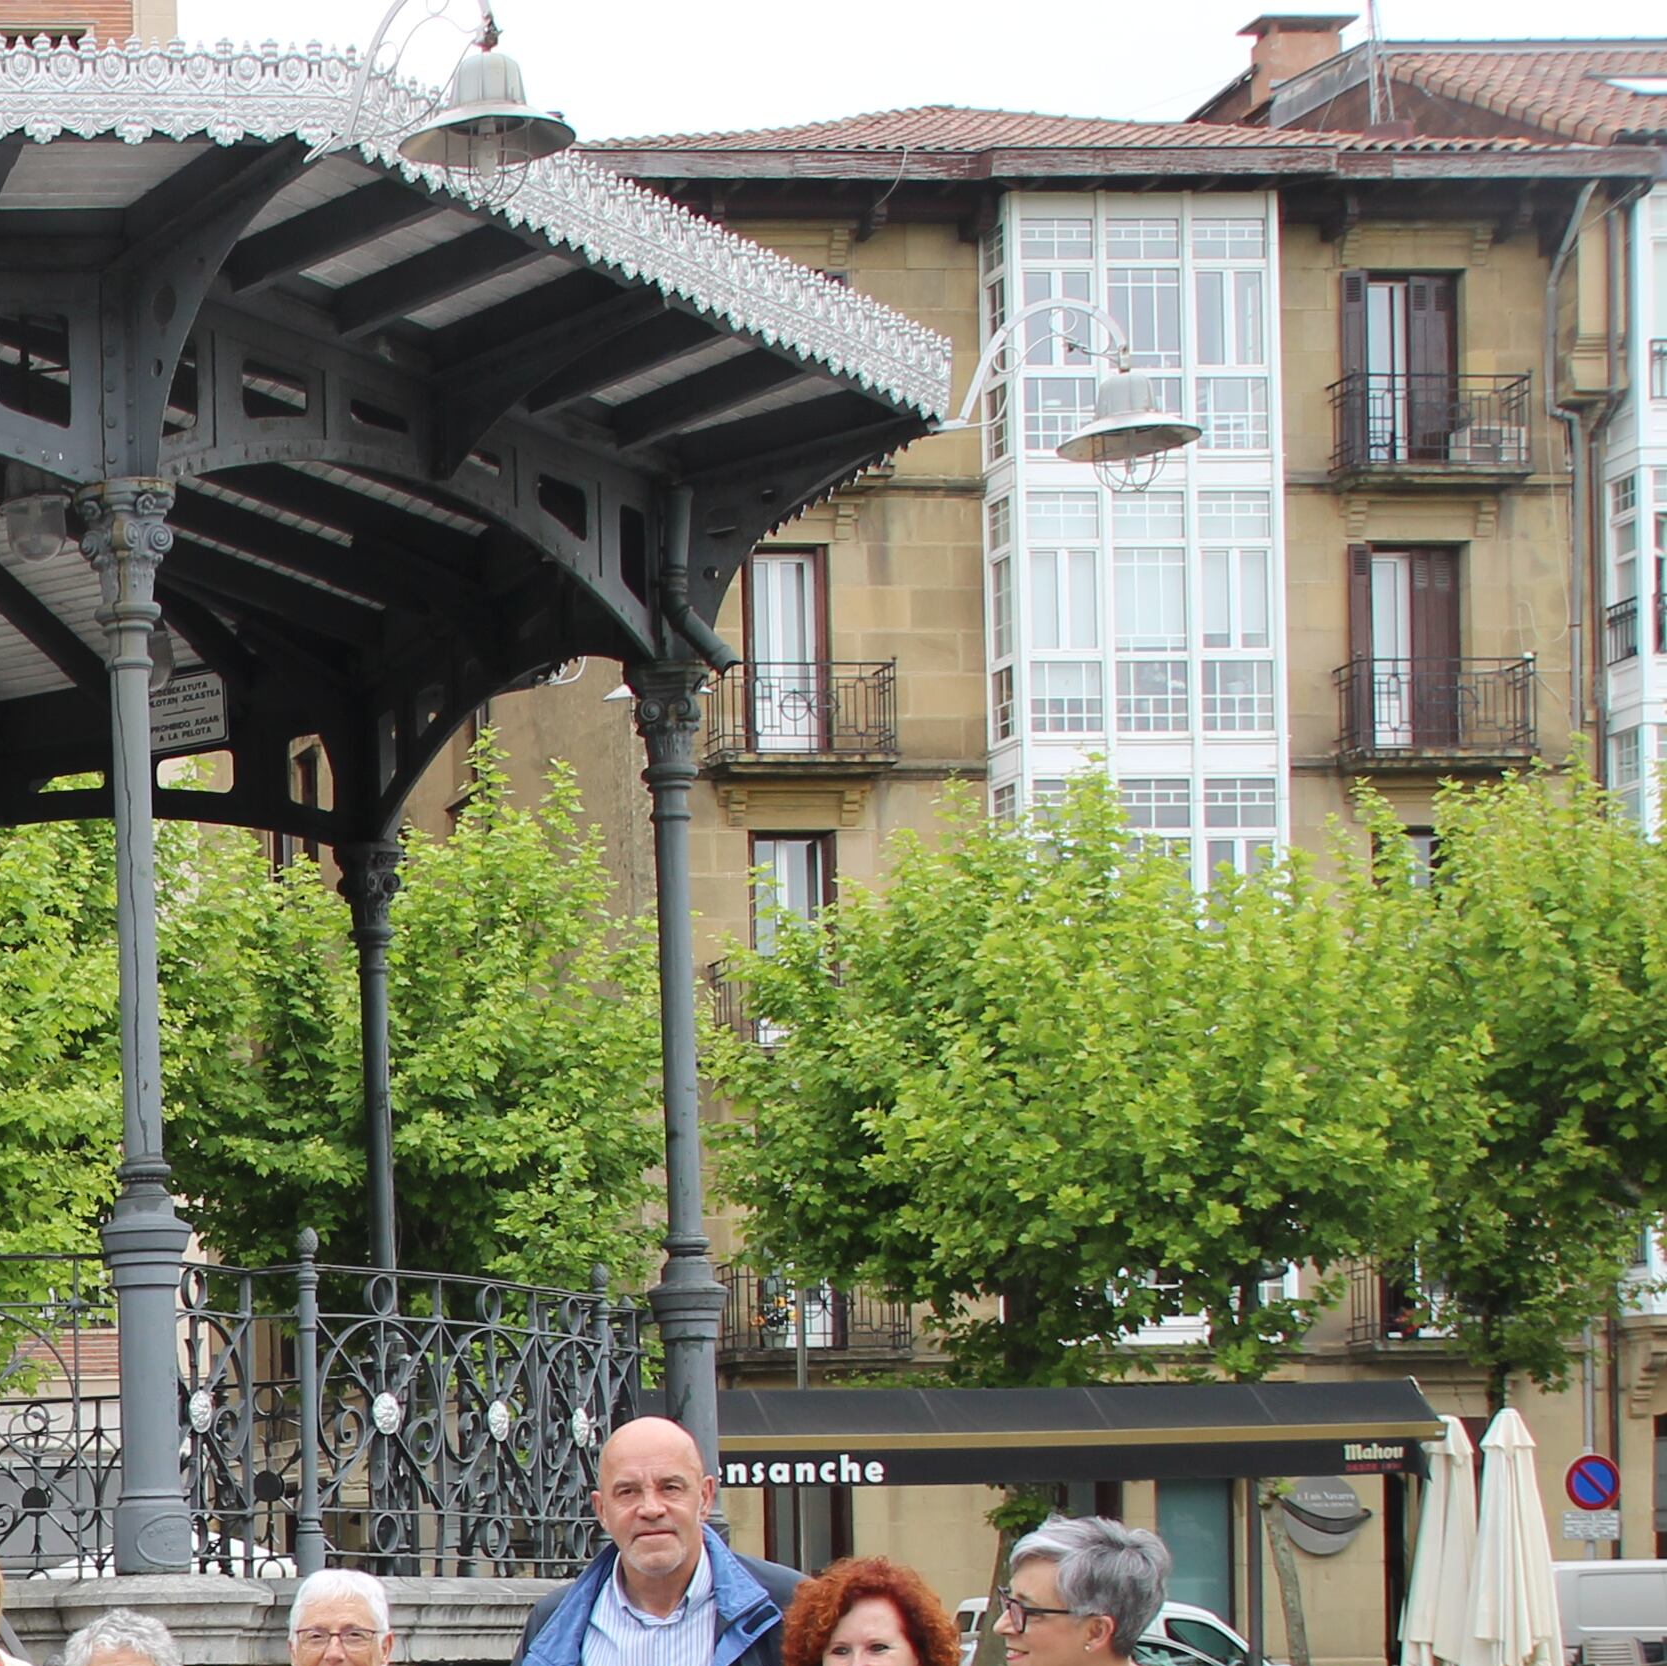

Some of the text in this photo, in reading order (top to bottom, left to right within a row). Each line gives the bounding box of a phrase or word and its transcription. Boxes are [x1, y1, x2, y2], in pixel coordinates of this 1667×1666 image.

[182, 689, 221, 702] JOLASTEA
[168, 733, 178, 741] LA
[182, 726, 212, 738] PELOTA
[1344, 1443, 1404, 1460] Mahou
[717, 1454, 884, 1484] nsanche
